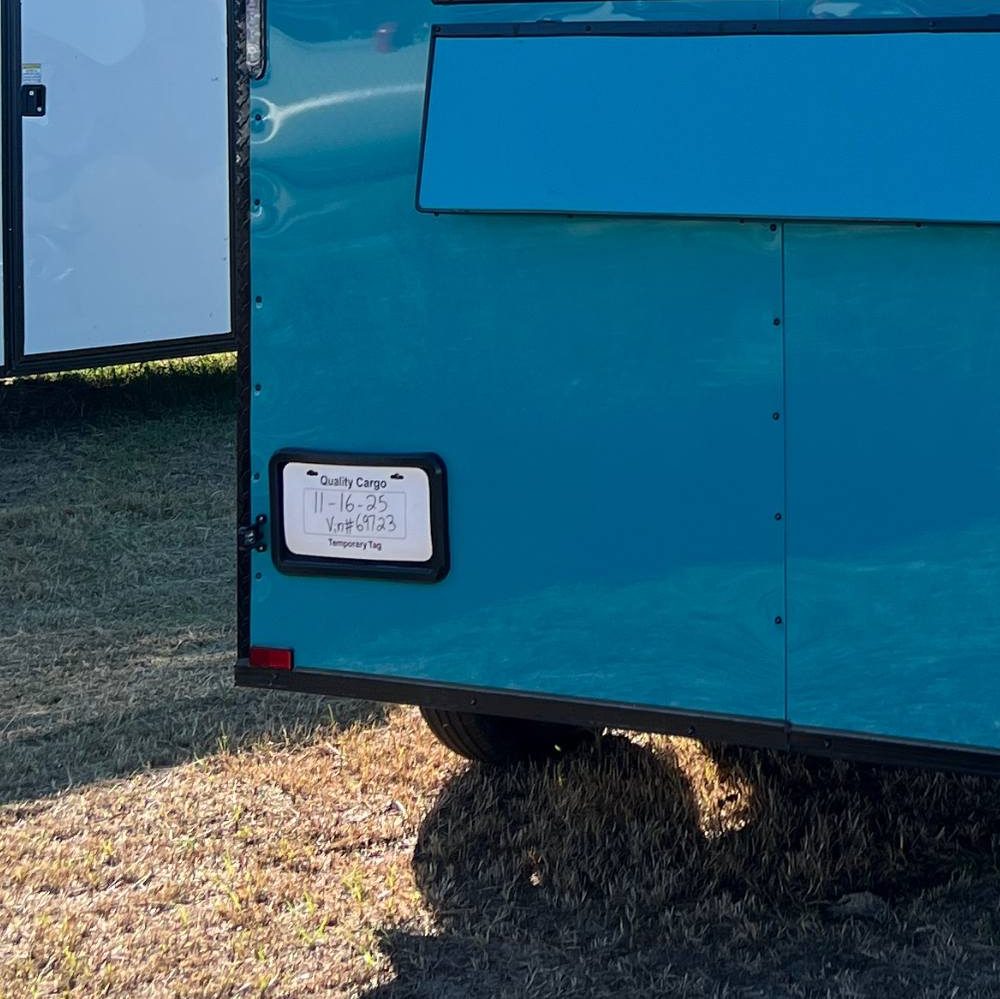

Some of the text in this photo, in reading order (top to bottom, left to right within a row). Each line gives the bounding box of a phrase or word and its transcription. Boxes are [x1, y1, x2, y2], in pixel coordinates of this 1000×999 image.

[320, 475, 387, 491] Quality Cargo
[314, 491, 388, 514] 11-16-25
[328, 538, 382, 551] Temporary Tag
